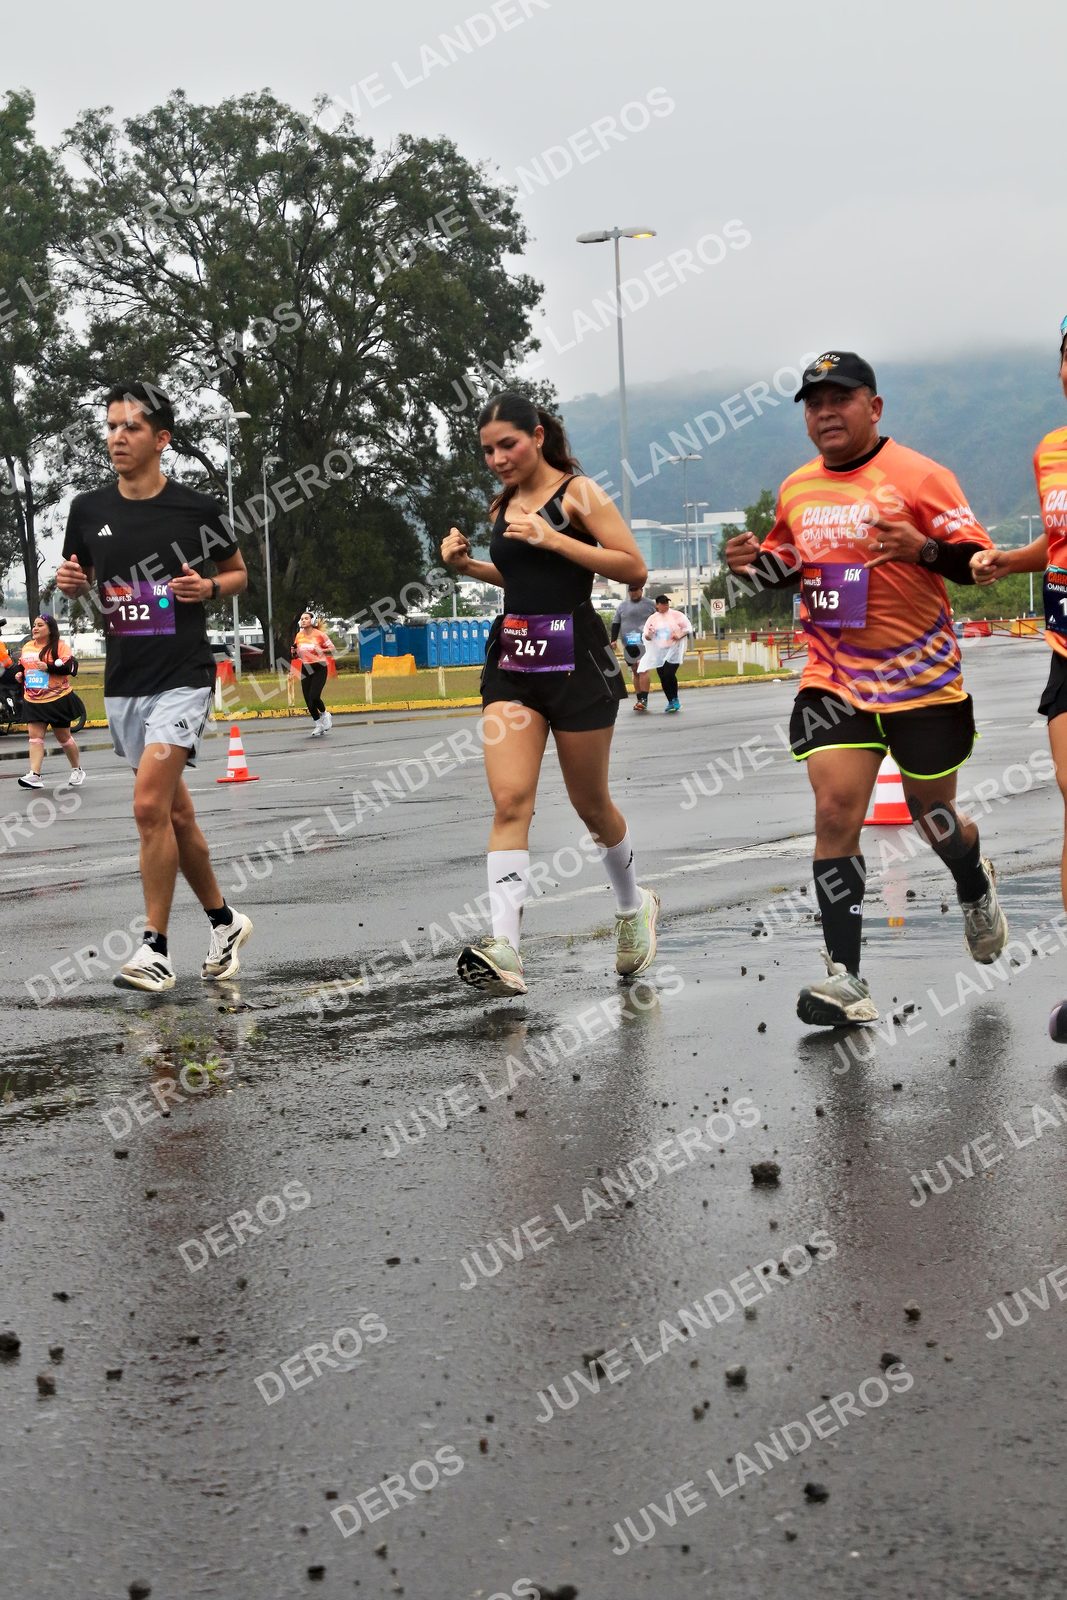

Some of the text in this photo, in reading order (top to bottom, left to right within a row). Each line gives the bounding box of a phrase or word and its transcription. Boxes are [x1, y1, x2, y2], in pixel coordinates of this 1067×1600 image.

[811, 590, 839, 609] 143
[118, 604, 150, 621] 132
[514, 639, 547, 656] 247
